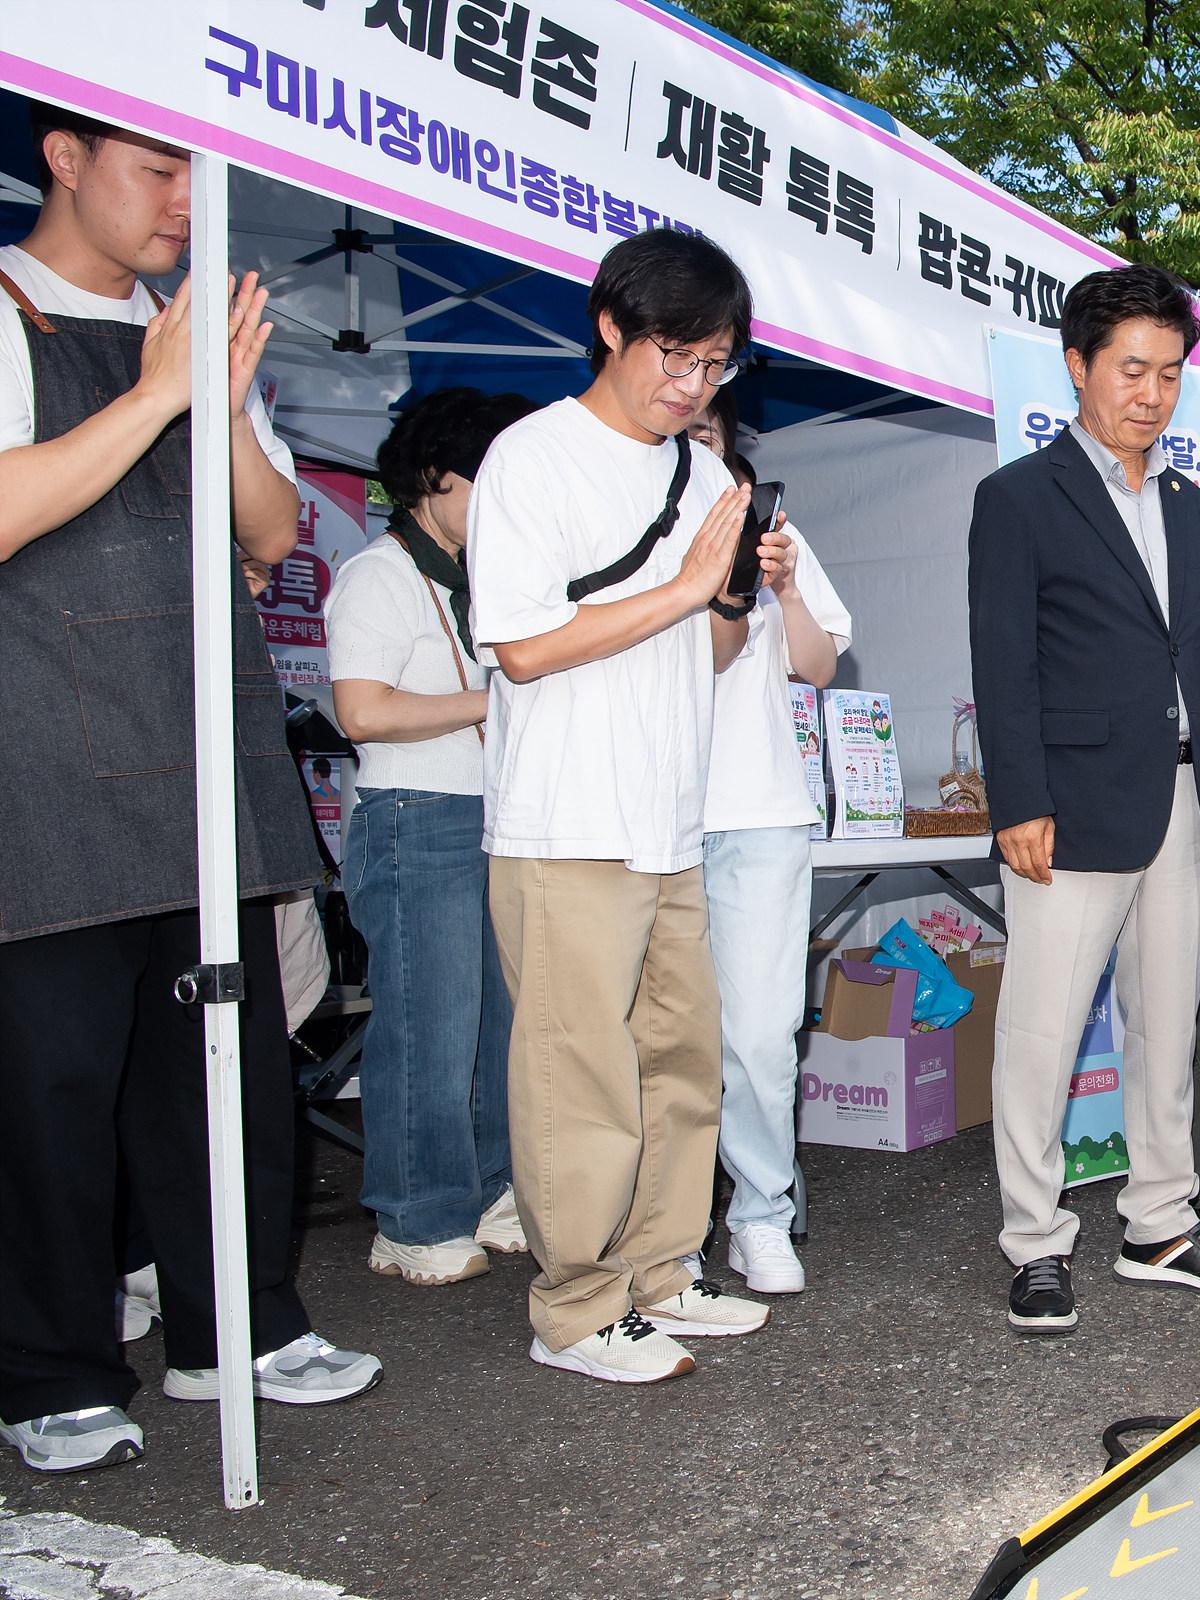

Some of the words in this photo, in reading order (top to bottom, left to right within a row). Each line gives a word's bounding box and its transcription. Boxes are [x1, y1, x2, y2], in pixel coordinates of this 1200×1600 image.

[204, 25, 704, 239] 구미시장애인종합복
[657, 80, 770, 207] 재활
[786, 145, 876, 255] 톡톡
[263, 618, 322, 641] 운동체험
[275, 659, 292, 671] 임을
[794, 720, 811, 731] 보세요!
[802, 1072, 889, 1108] Dream
[1077, 1072, 1116, 1092] 문의전화
[878, 1138, 889, 1147] A4
